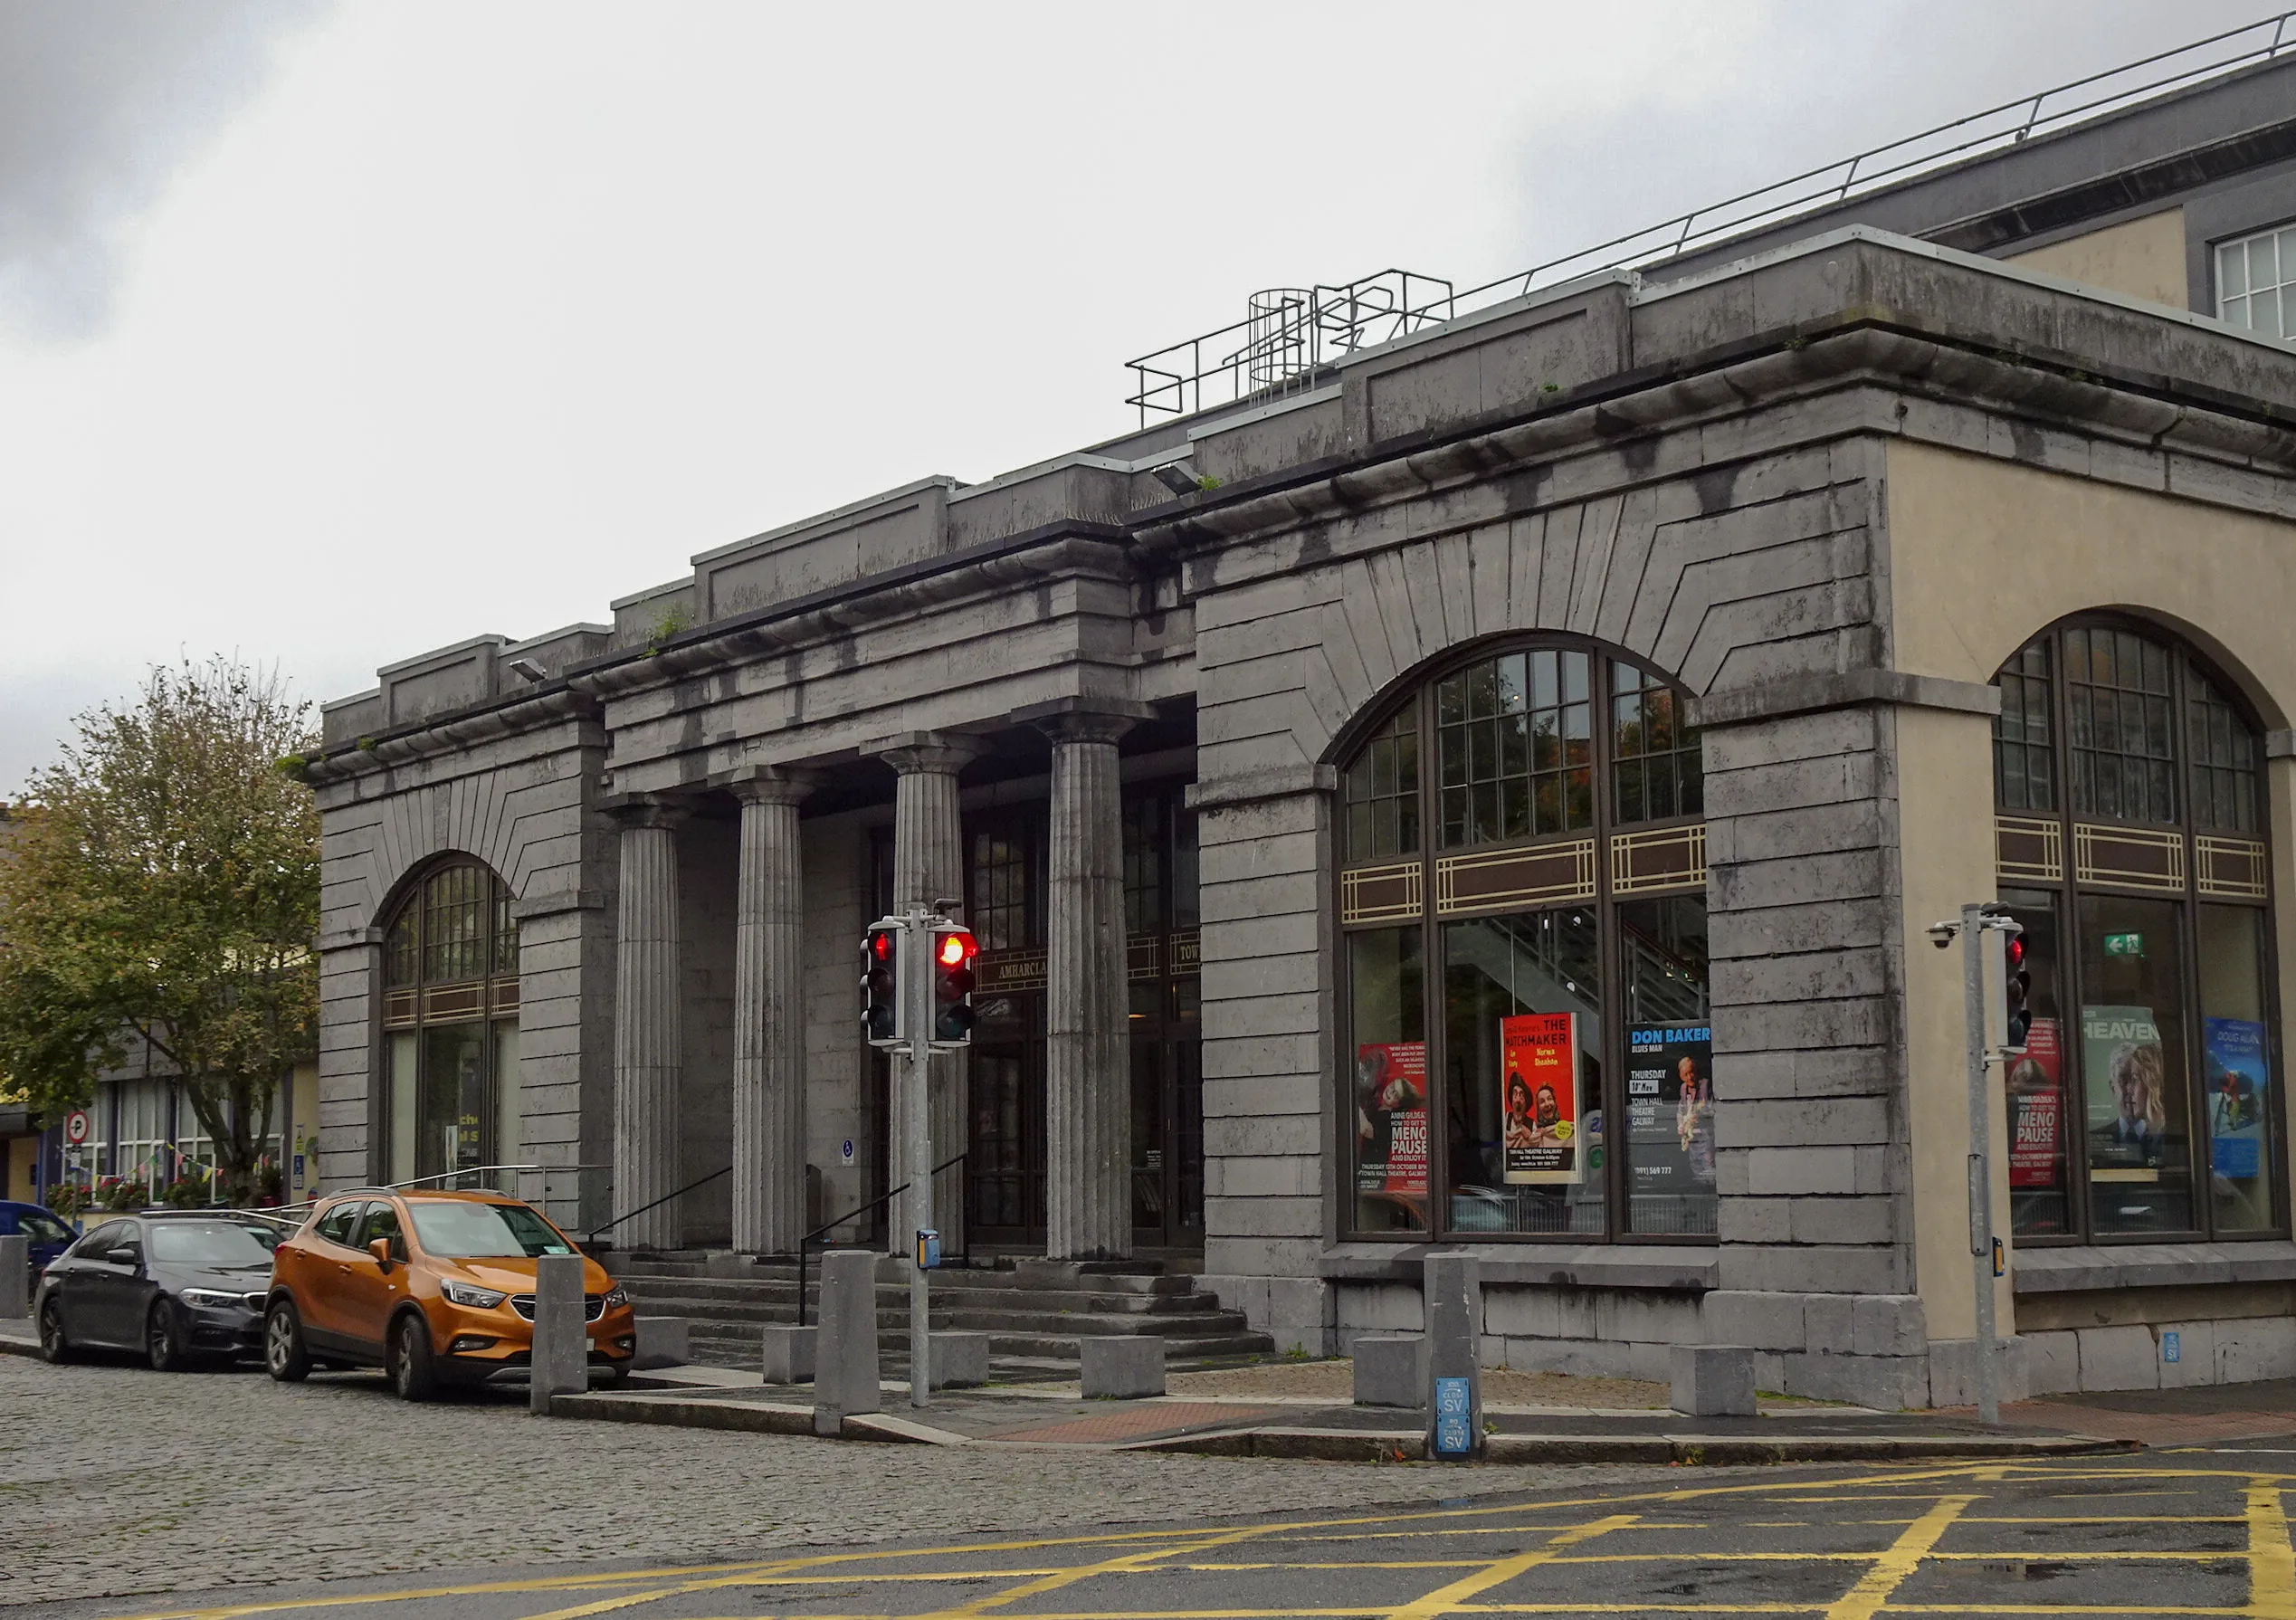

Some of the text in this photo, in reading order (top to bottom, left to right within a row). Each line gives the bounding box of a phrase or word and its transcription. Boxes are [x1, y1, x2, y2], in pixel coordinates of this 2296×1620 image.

[1544, 1019, 1567, 1031] THE
[2083, 1022, 2161, 1041] HEAVEN
[1505, 1034, 1567, 1047] MATCHMAKER
[1632, 1027, 1711, 1044] DON BAKER
[1632, 1044, 1648, 1053] BLUES
[1631, 1070, 1667, 1079] THURSDAY
[1631, 1097, 1663, 1106] TOWN HALL
[1632, 1107, 1655, 1116] THEATRE
[1632, 1117, 1654, 1126] GALWAY
[2017, 1111, 2055, 1127] MENO
[1391, 1126, 1427, 1140] MENO
[2015, 1127, 2053, 1142] PAUSE
[1391, 1140, 1427, 1154] PAUSE
[1444, 1399, 1463, 1412] SV
[1444, 1436, 1463, 1448] SV
